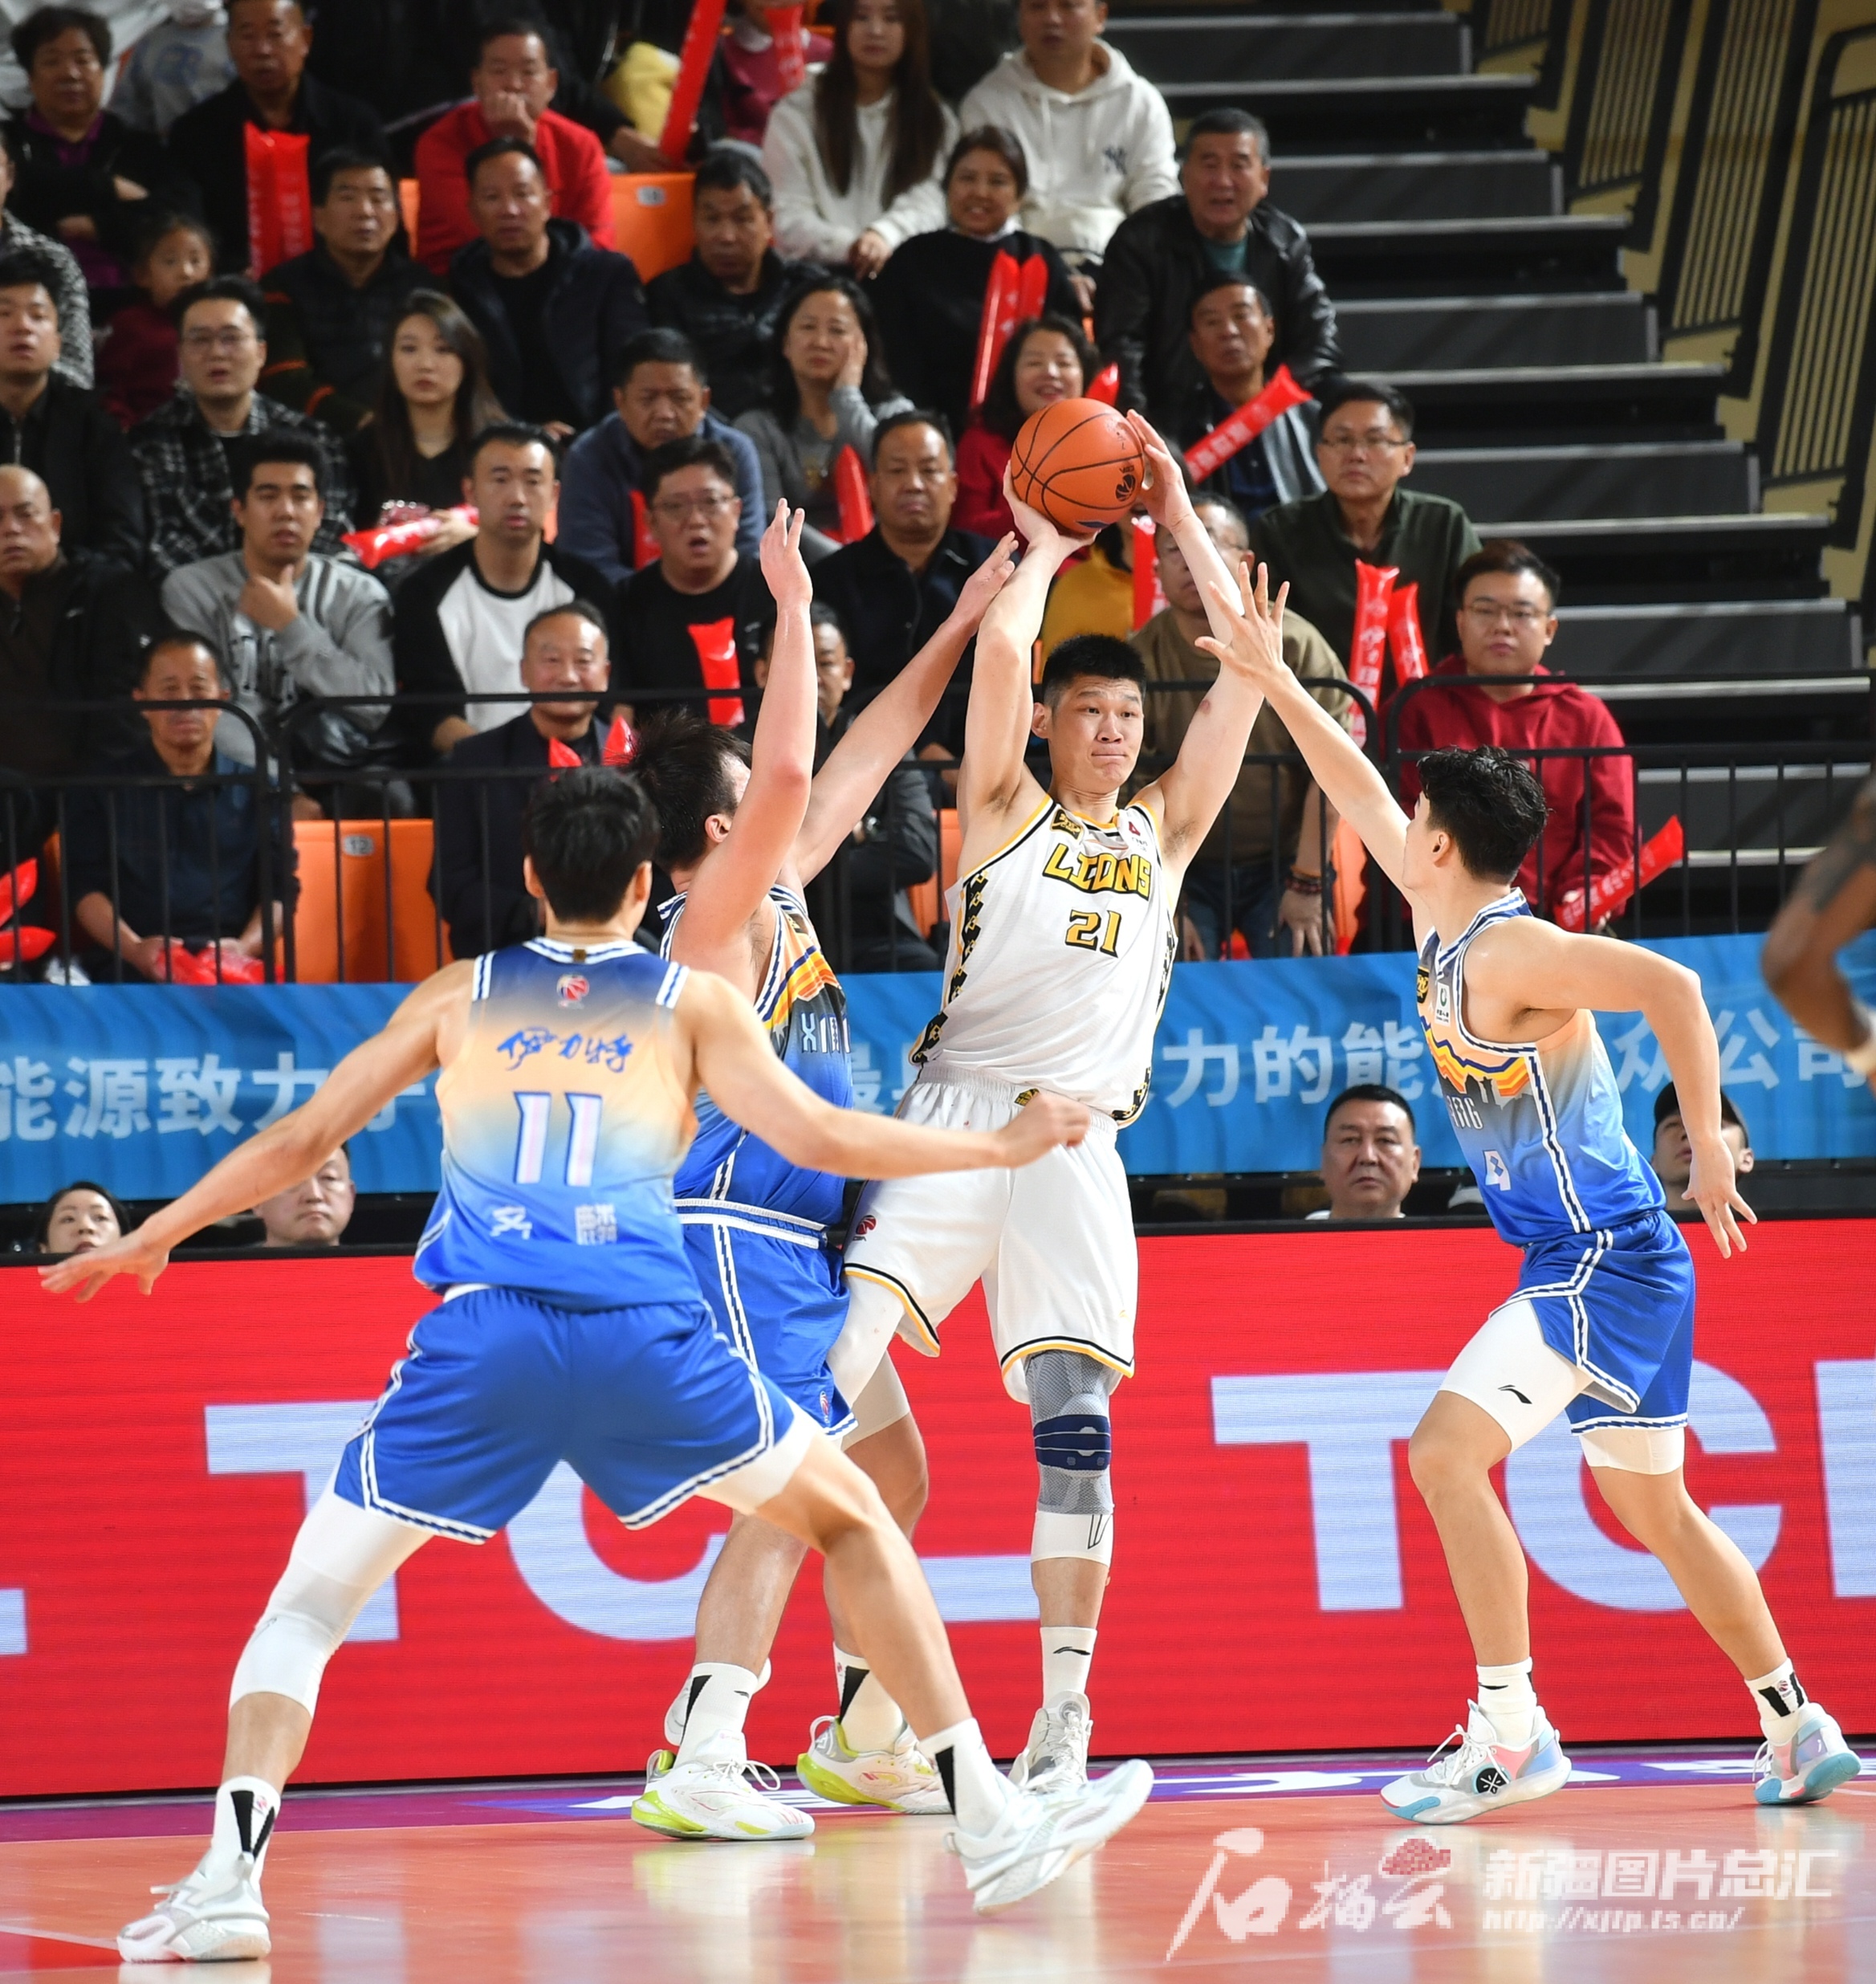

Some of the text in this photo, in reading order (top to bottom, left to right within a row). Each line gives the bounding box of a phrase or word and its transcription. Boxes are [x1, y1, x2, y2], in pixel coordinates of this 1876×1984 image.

[1042, 843, 1152, 901] LIONS
[1064, 909, 1122, 958] 21
[514, 1090, 603, 1187] 11
[1483, 1150, 1512, 1191] 4
